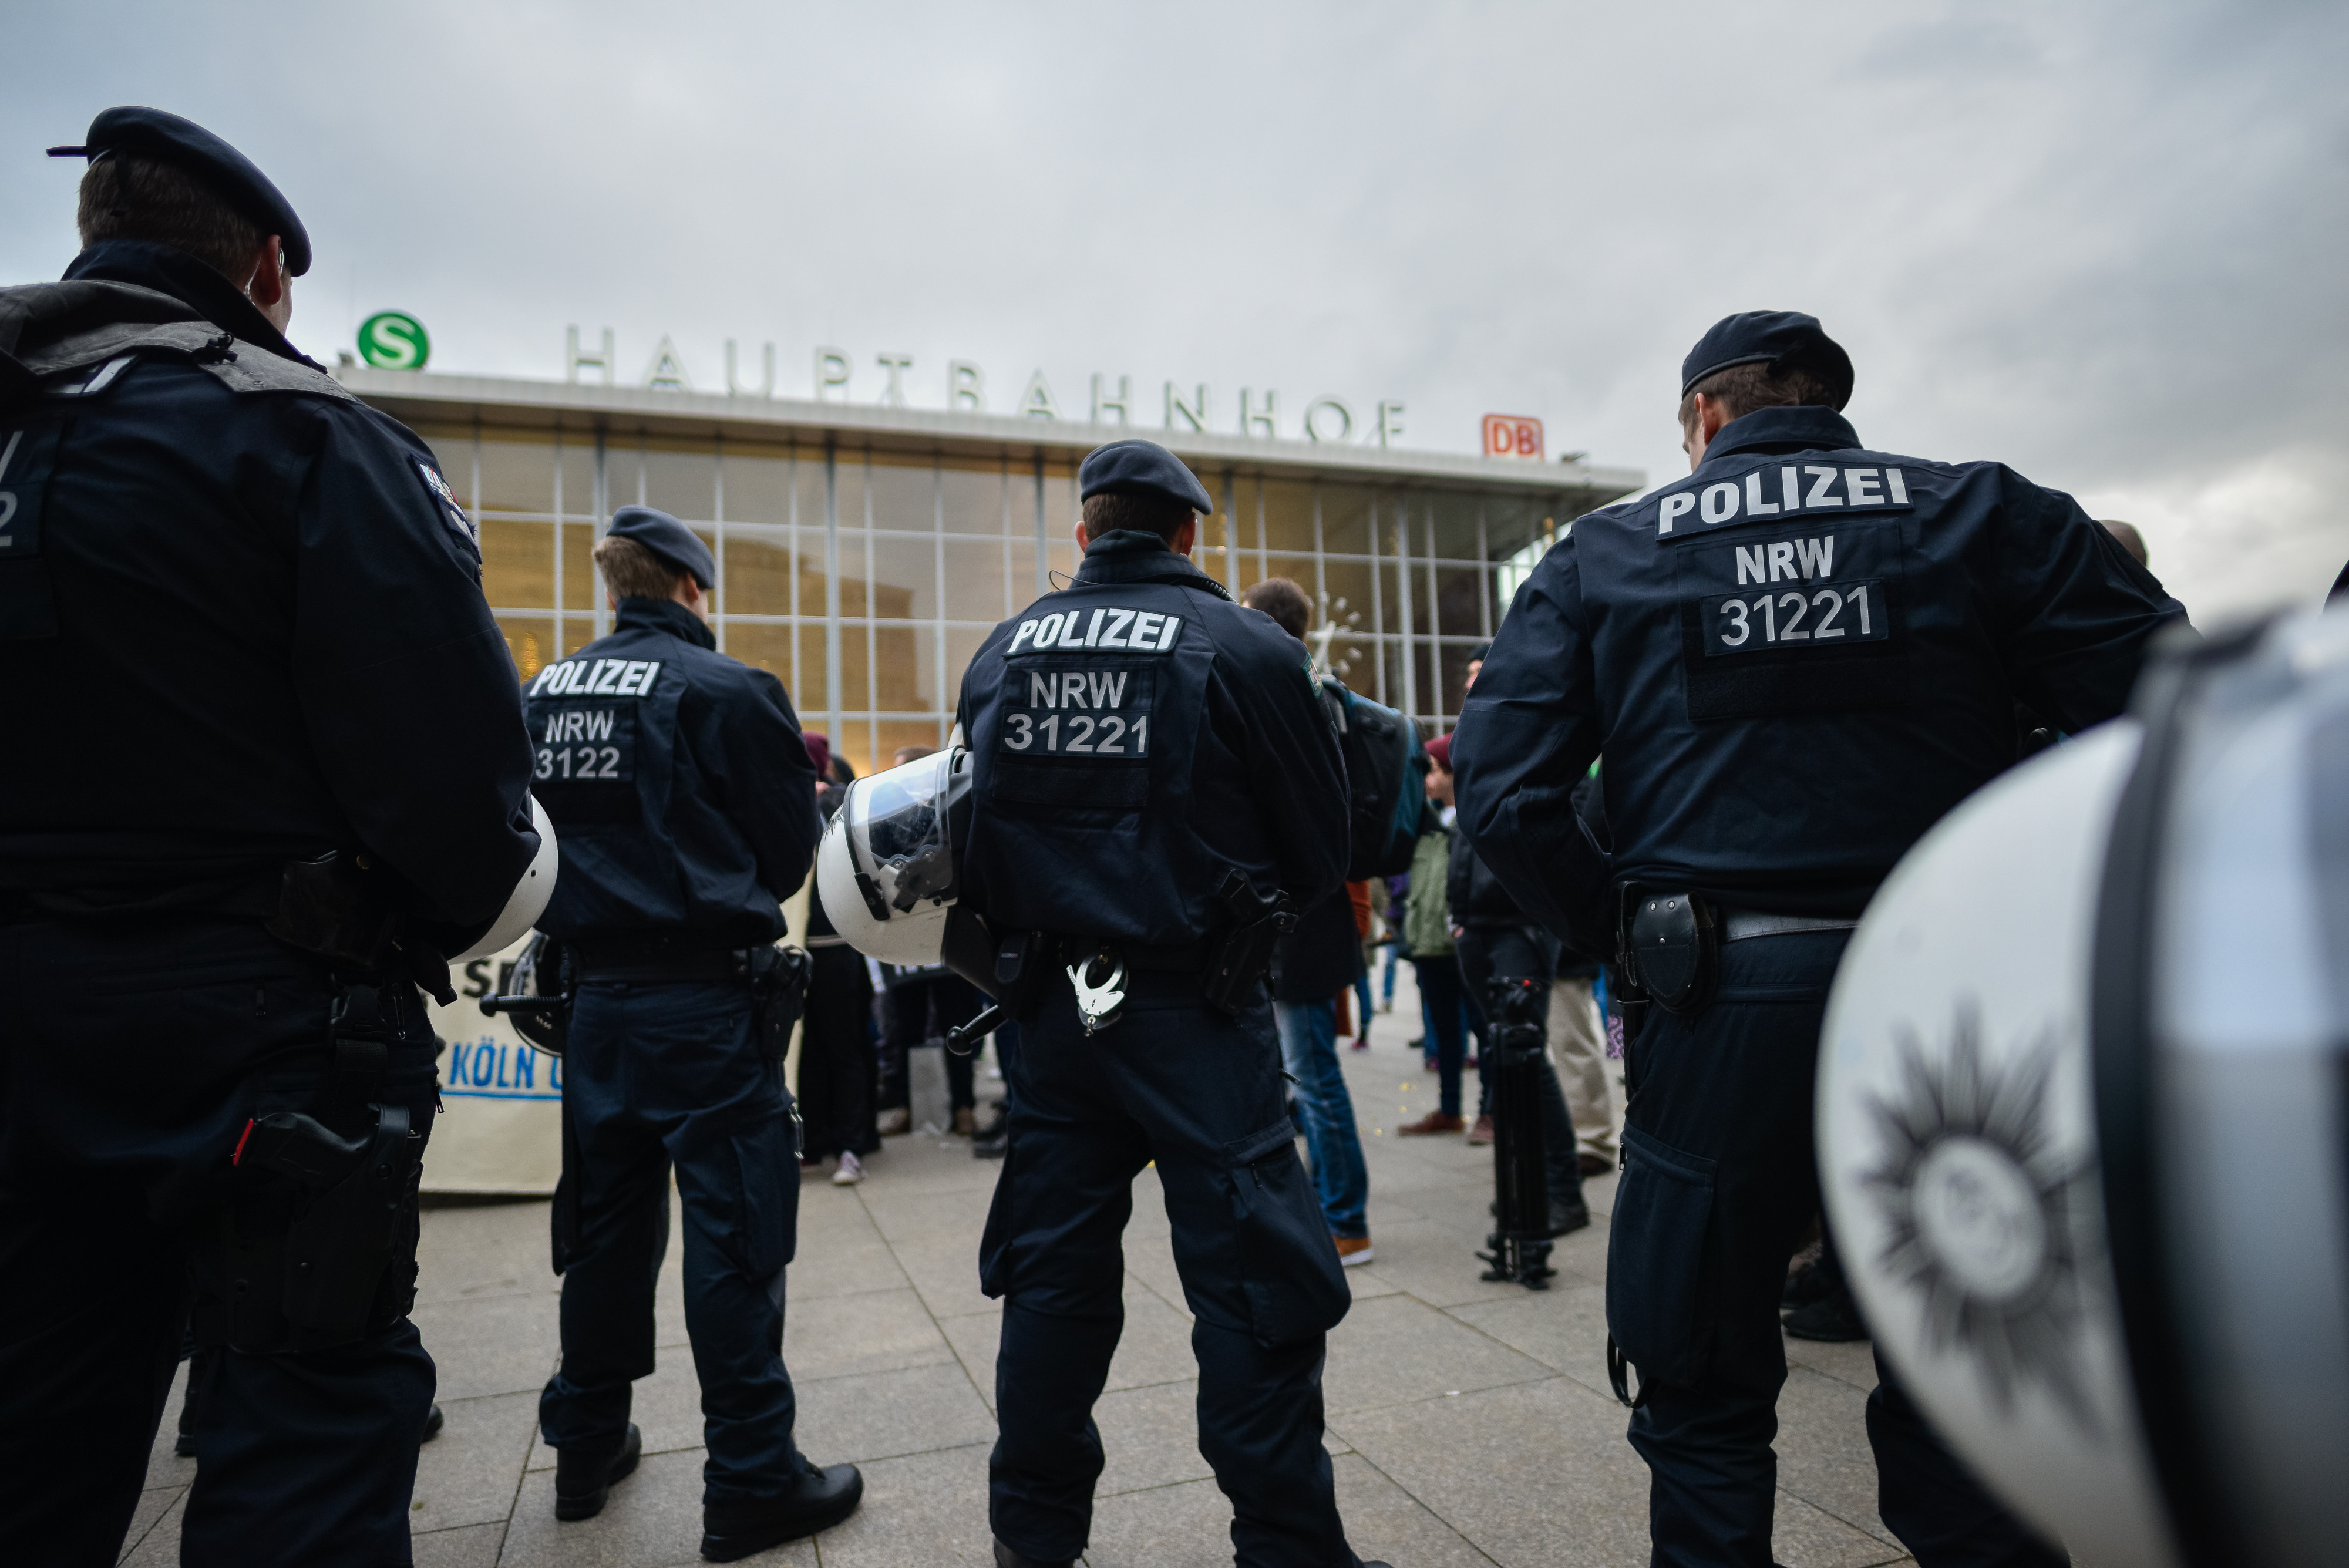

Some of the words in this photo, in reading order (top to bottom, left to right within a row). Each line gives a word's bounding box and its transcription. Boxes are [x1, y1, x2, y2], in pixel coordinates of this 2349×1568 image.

[371, 315, 418, 368] S
[566, 322, 1406, 449] HAUPTBAHNHOF
[1492, 421, 1536, 455] DB
[1658, 465, 1909, 535] POLIZEI
[1735, 534, 1835, 586] NRW
[1006, 607, 1180, 654] POLIZEI
[1719, 585, 1872, 647] 31221
[529, 658, 661, 698] POLIZEI
[1030, 671, 1128, 709] NRW
[545, 709, 615, 744] NRW
[1004, 712, 1147, 753] 31221
[534, 746, 620, 779] 3122
[449, 1035, 536, 1089] KÖLN
